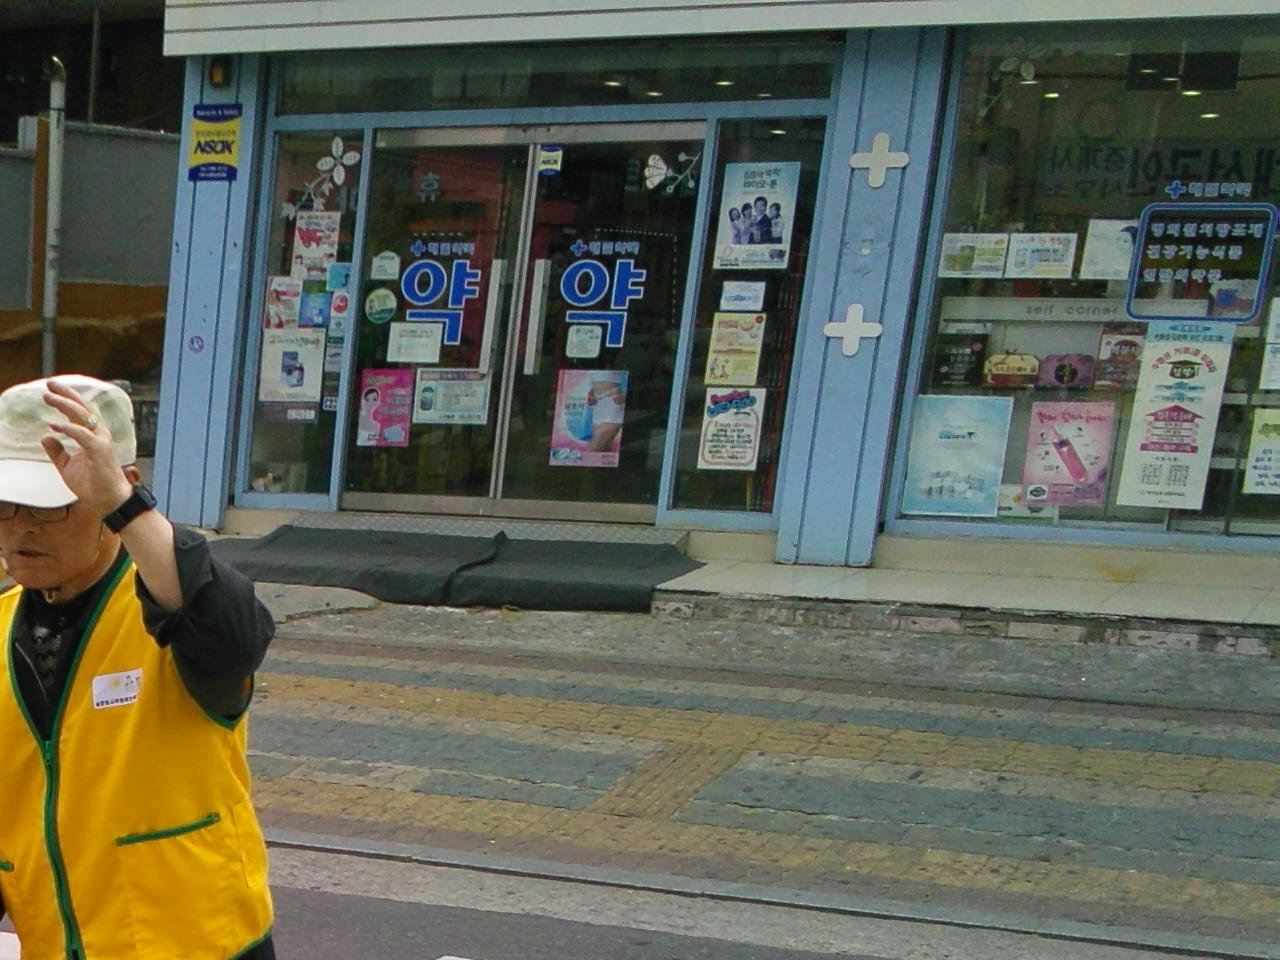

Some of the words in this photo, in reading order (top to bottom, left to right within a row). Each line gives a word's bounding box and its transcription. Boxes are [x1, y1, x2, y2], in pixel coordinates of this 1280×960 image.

[400, 259, 482, 346] 약
[560, 259, 648, 348] 약
[1066, 304, 1119, 317] corner
